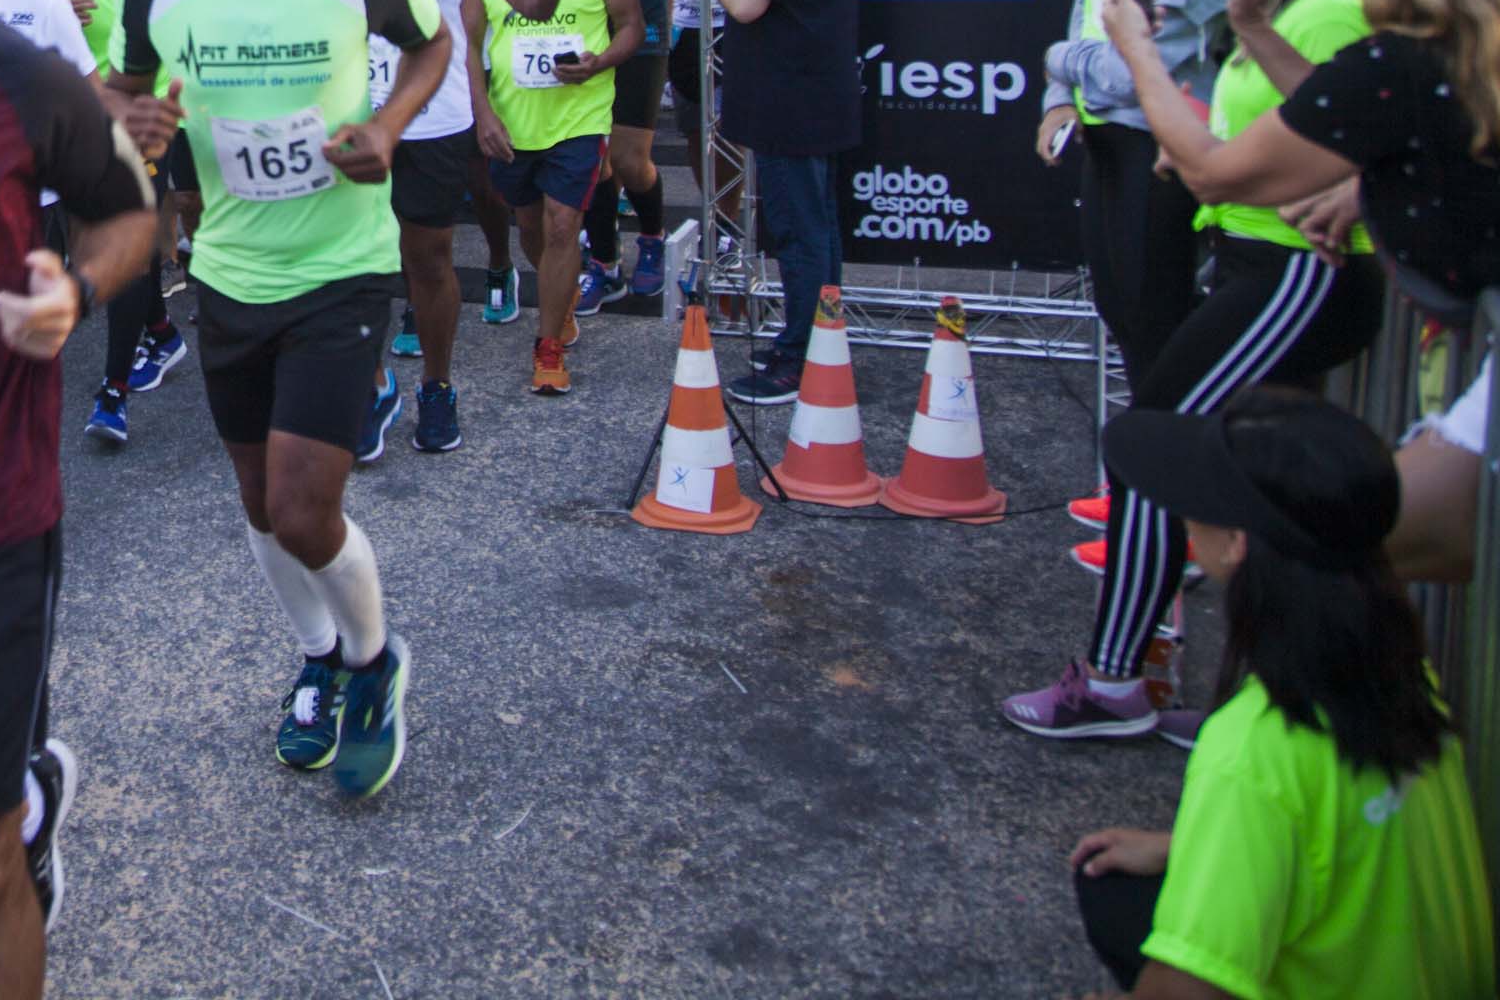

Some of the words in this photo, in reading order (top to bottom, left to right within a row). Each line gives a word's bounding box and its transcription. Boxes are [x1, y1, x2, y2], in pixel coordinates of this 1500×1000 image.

[200, 45, 228, 60] FIT
[237, 41, 329, 60] RUNNERS
[524, 54, 551, 74] 76
[236, 139, 313, 180] 165
[853, 164, 949, 200] globo
[871, 195, 969, 217] esporte
[853, 215, 992, 247] .com/pb
